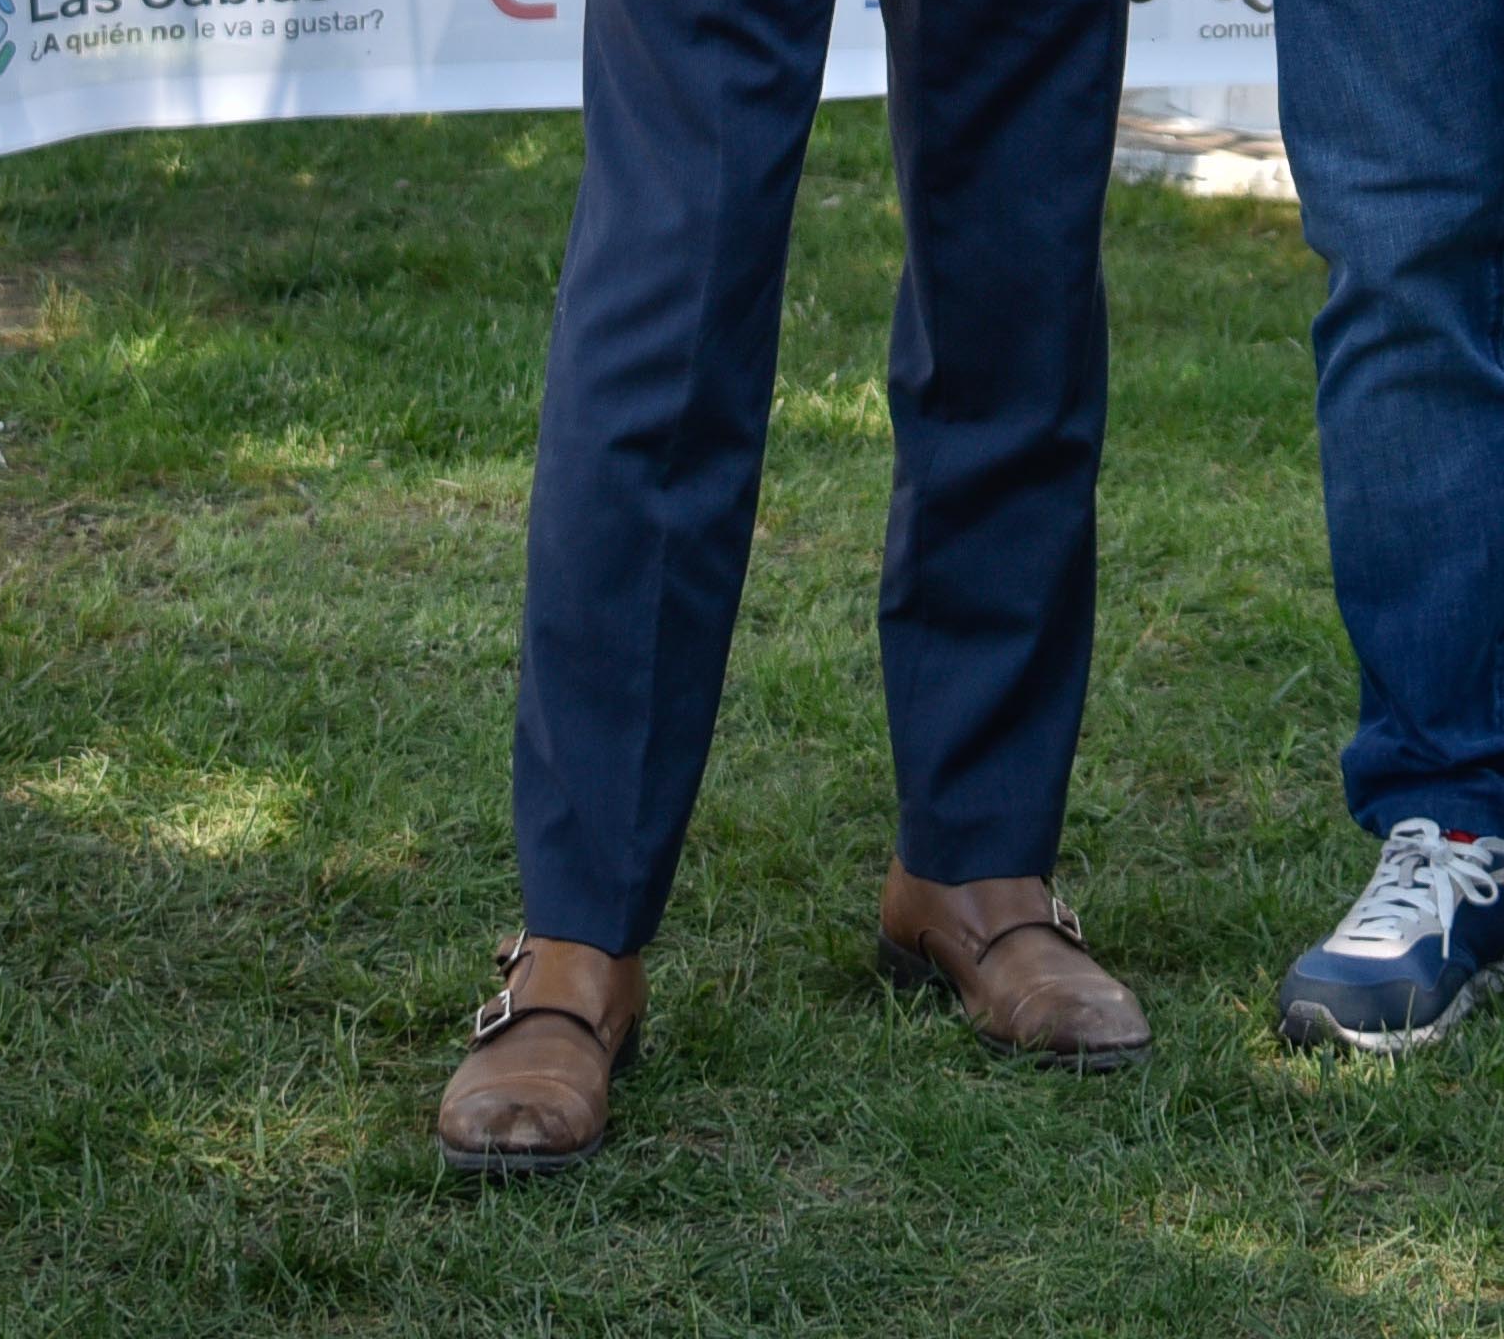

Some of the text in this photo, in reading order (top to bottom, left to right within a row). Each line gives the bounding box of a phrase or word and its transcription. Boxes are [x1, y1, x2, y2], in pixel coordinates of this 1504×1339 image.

[30, 8, 385, 62] ¿A quién no le va a gustar?
